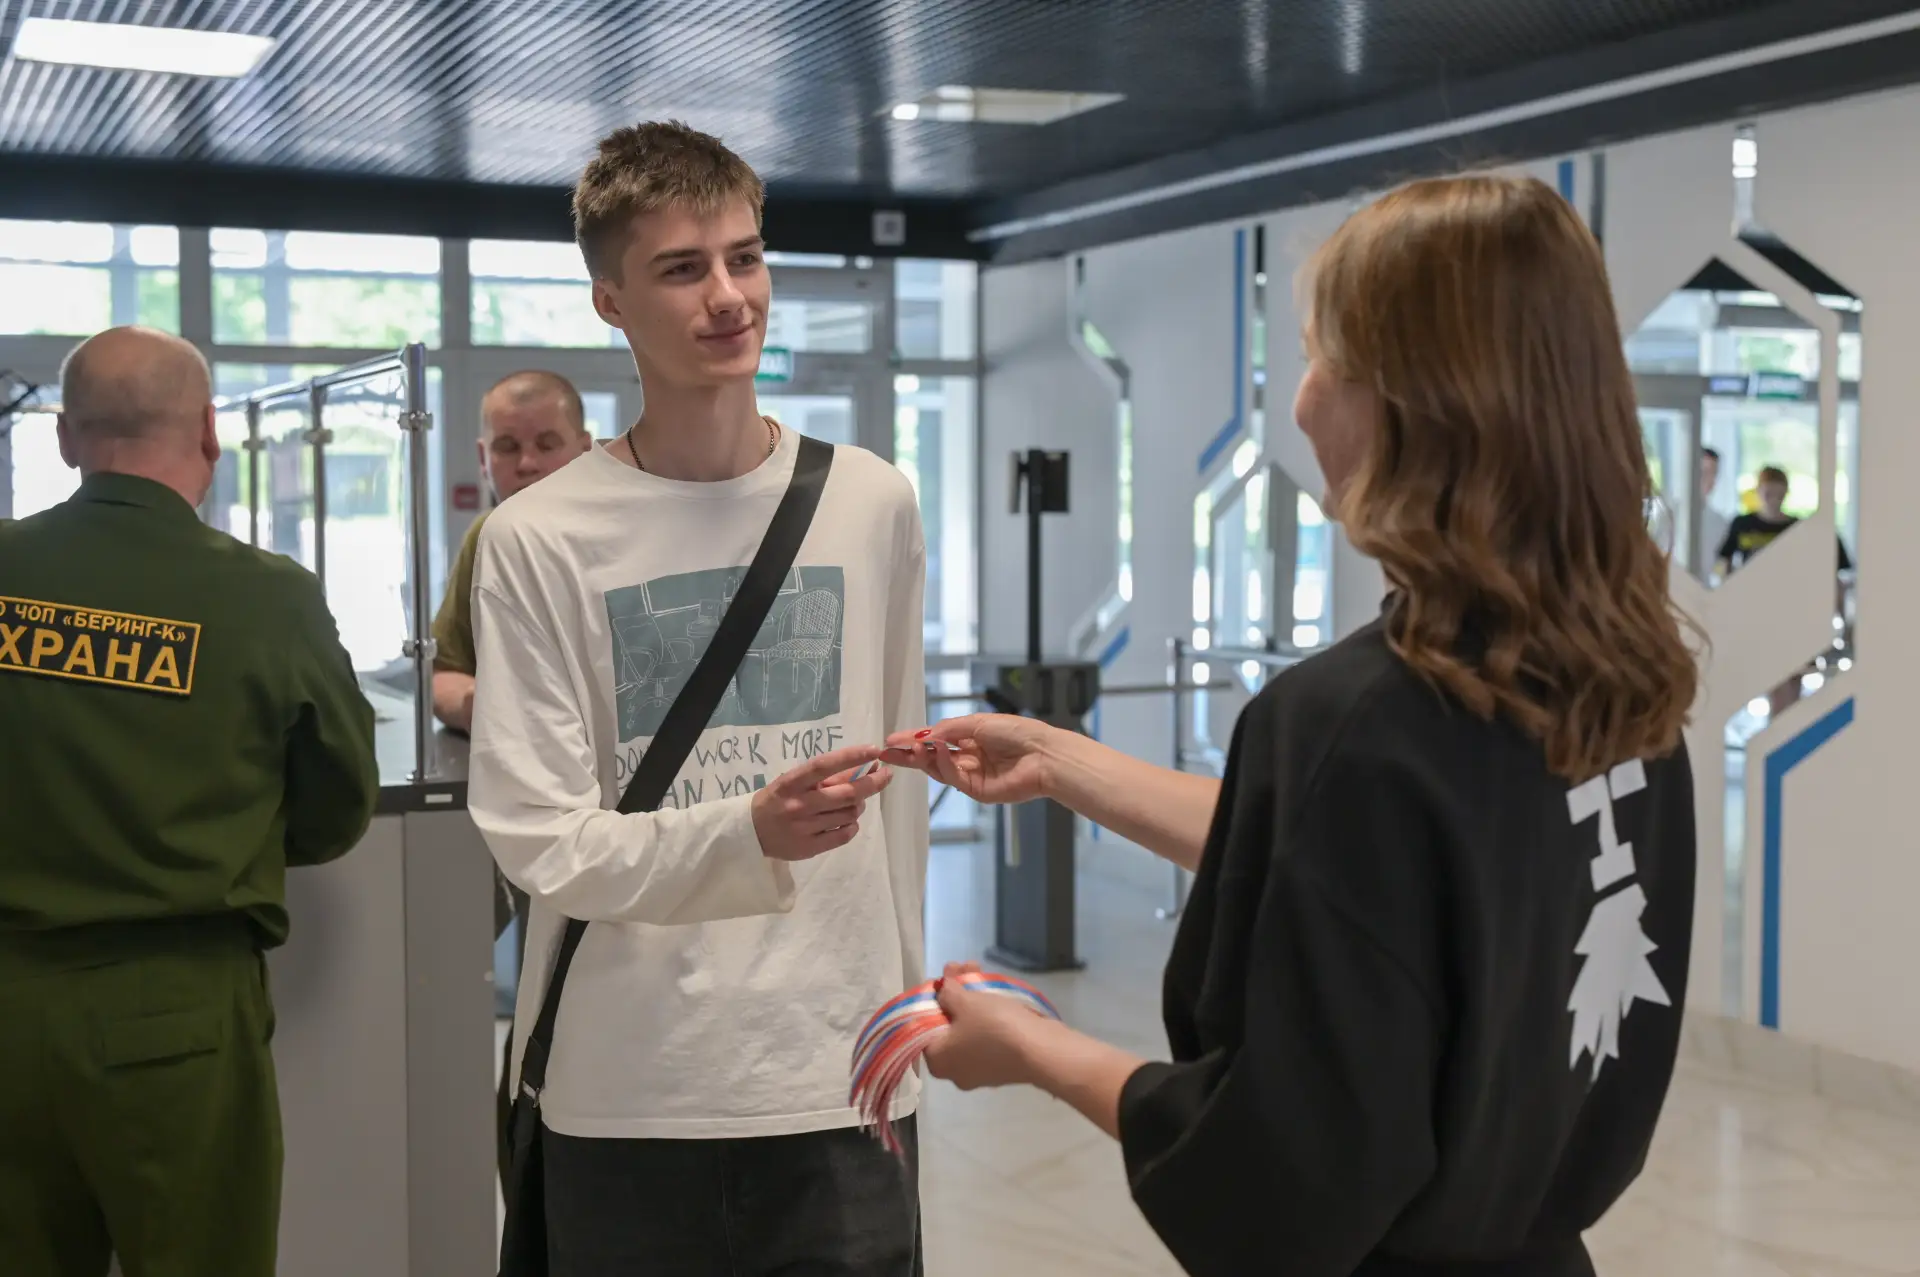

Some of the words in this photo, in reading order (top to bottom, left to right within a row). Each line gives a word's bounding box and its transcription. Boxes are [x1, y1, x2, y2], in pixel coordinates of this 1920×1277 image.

[15, 604, 56, 625] ЧОП
[63, 611, 186, 642] «БЕРИНГ-К»
[695, 733, 767, 768] WORK
